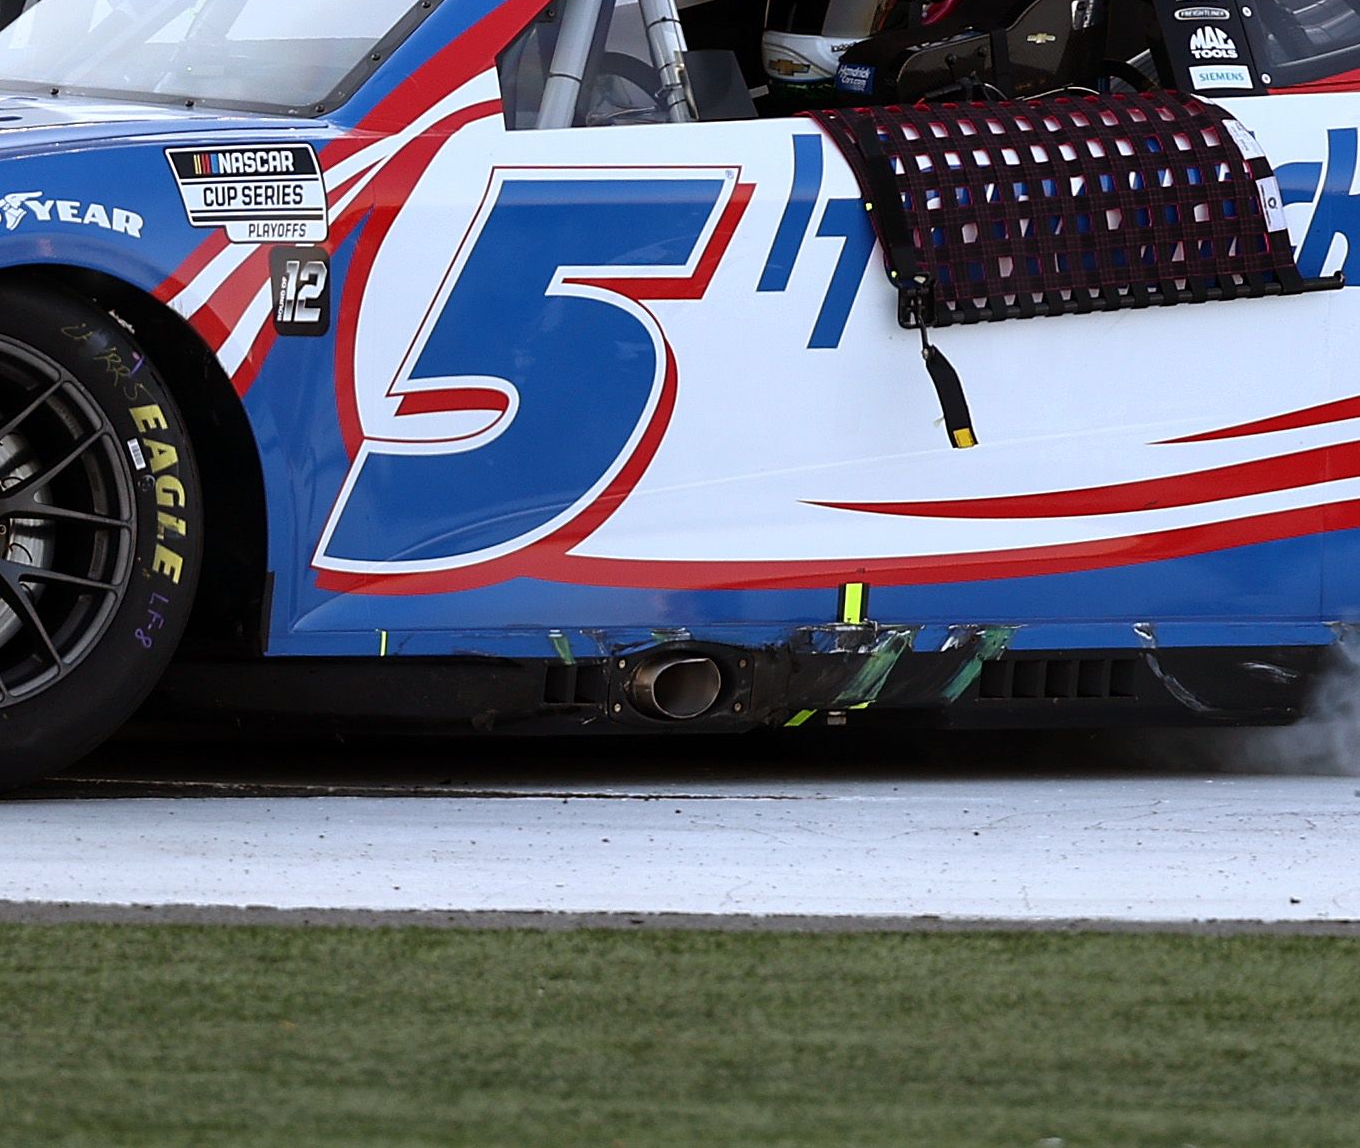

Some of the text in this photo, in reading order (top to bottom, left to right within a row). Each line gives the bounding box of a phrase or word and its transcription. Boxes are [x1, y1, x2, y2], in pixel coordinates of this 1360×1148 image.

[1190, 26, 1236, 50] MAC
[1191, 50, 1238, 59] TOOLS
[1199, 72, 1245, 81] SIEMENS
[219, 151, 294, 173] NASCAR
[203, 184, 303, 206] CUP SERIES
[249, 223, 307, 237] PLAYOFFS
[283, 260, 328, 322] 12
[314, 168, 735, 572] 5
[128, 404, 186, 585] EAGLE
